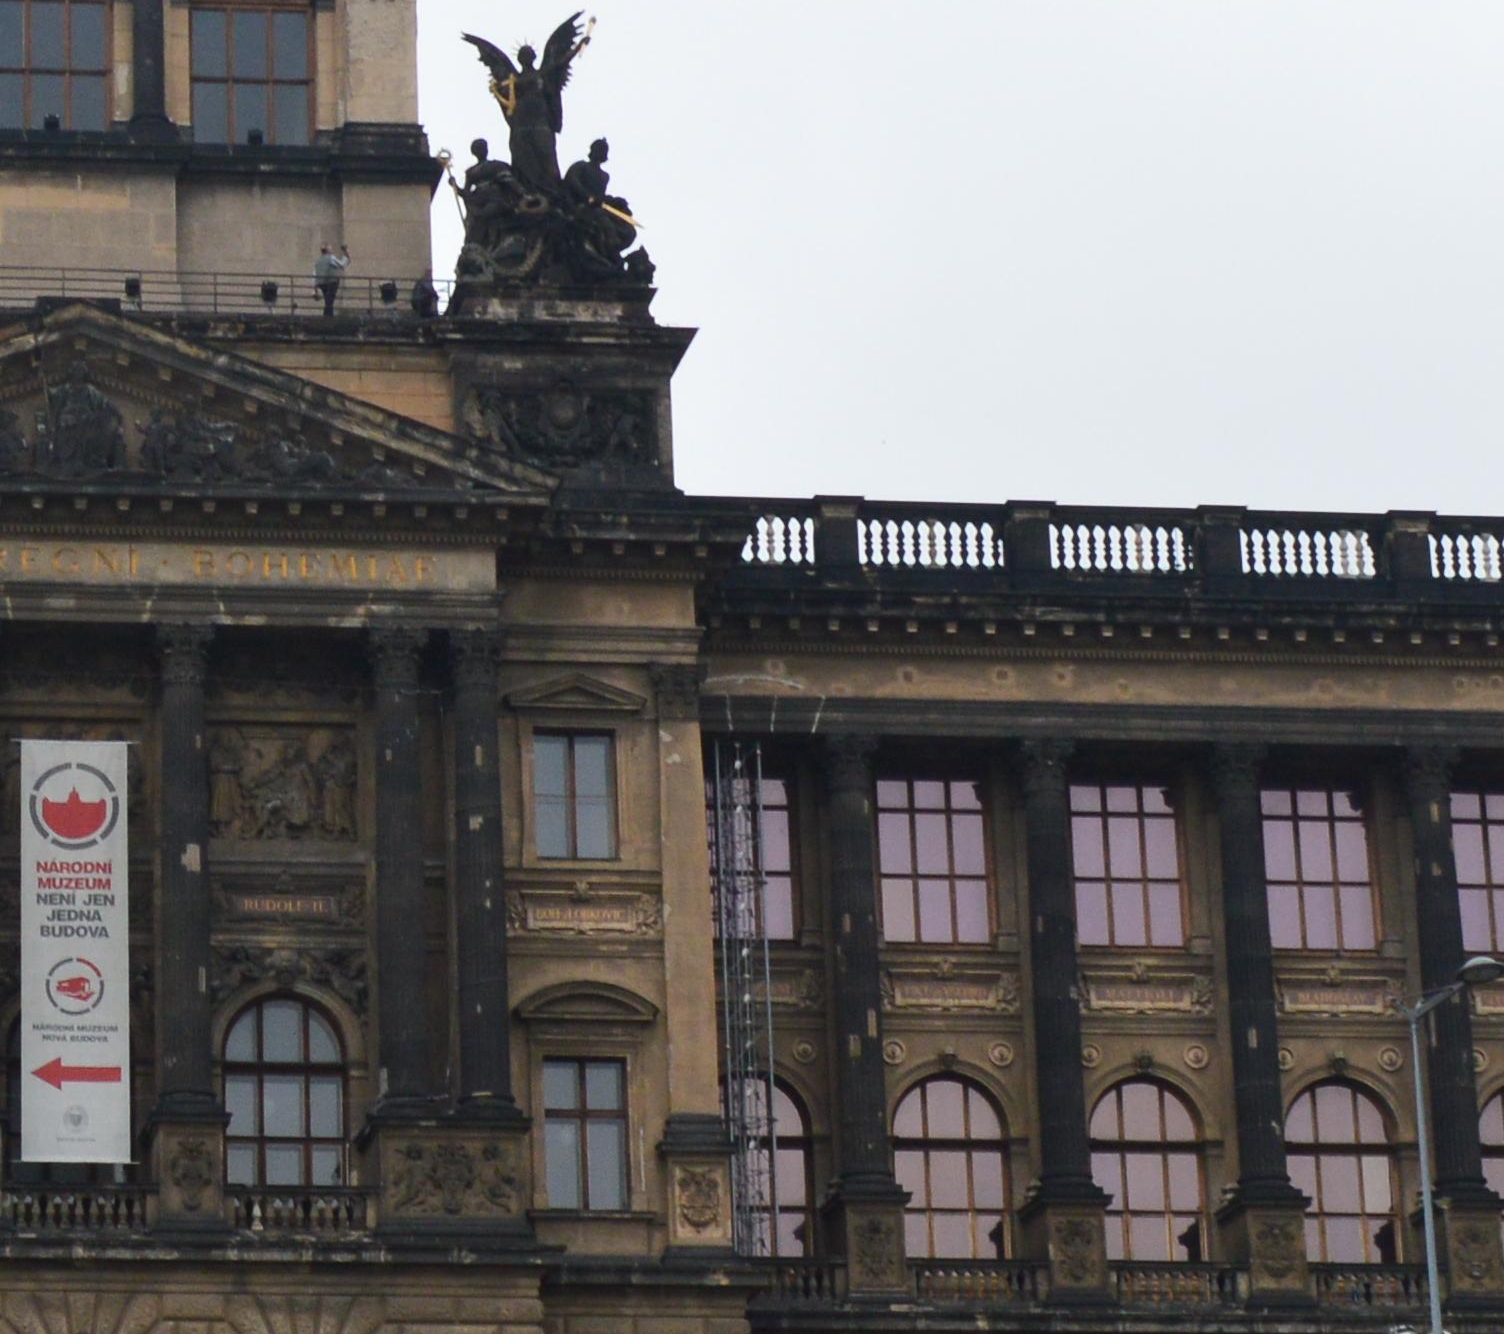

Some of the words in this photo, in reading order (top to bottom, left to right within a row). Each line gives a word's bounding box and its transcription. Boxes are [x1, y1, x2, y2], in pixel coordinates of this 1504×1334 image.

[193, 550, 437, 582] BOHEMIAE
[35, 857, 112, 874] NÁRODNÍ
[37, 877, 112, 890] MUZEUM
[35, 891, 76, 906] NENÍ
[83, 894, 115, 907] JEN
[244, 898, 304, 912] RUDOLF
[46, 909, 103, 922] JEDNA
[39, 925, 109, 939] BUDOVA
[70, 1034, 109, 1043] BUDOVA
